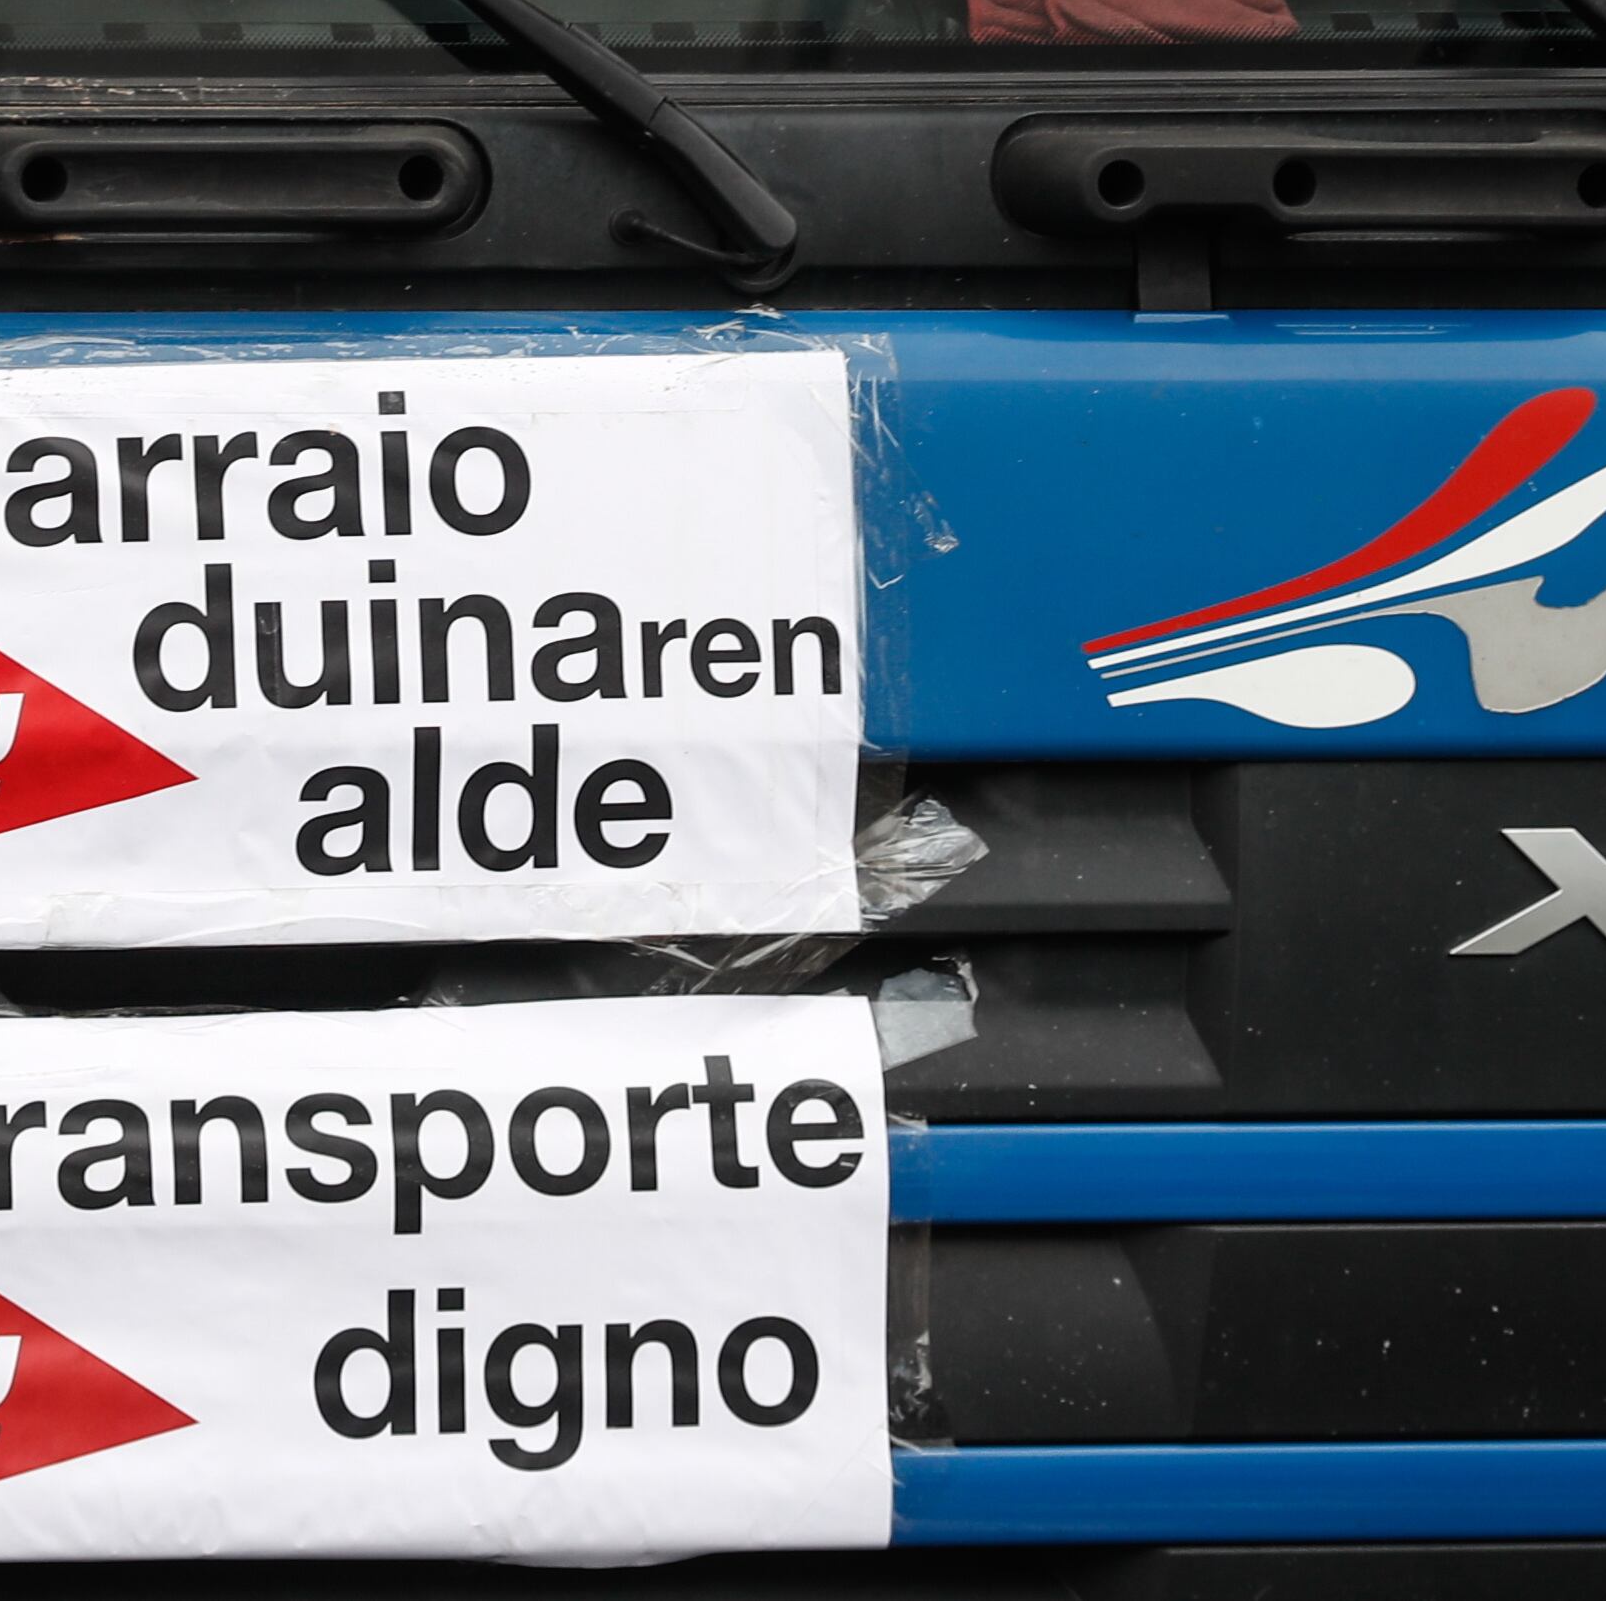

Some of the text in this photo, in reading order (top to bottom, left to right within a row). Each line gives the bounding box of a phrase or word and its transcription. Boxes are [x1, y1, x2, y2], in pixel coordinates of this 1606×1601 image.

[134, 560, 841, 712] duinaren
[296, 724, 672, 876] alde
[315, 1288, 818, 1470] digno
